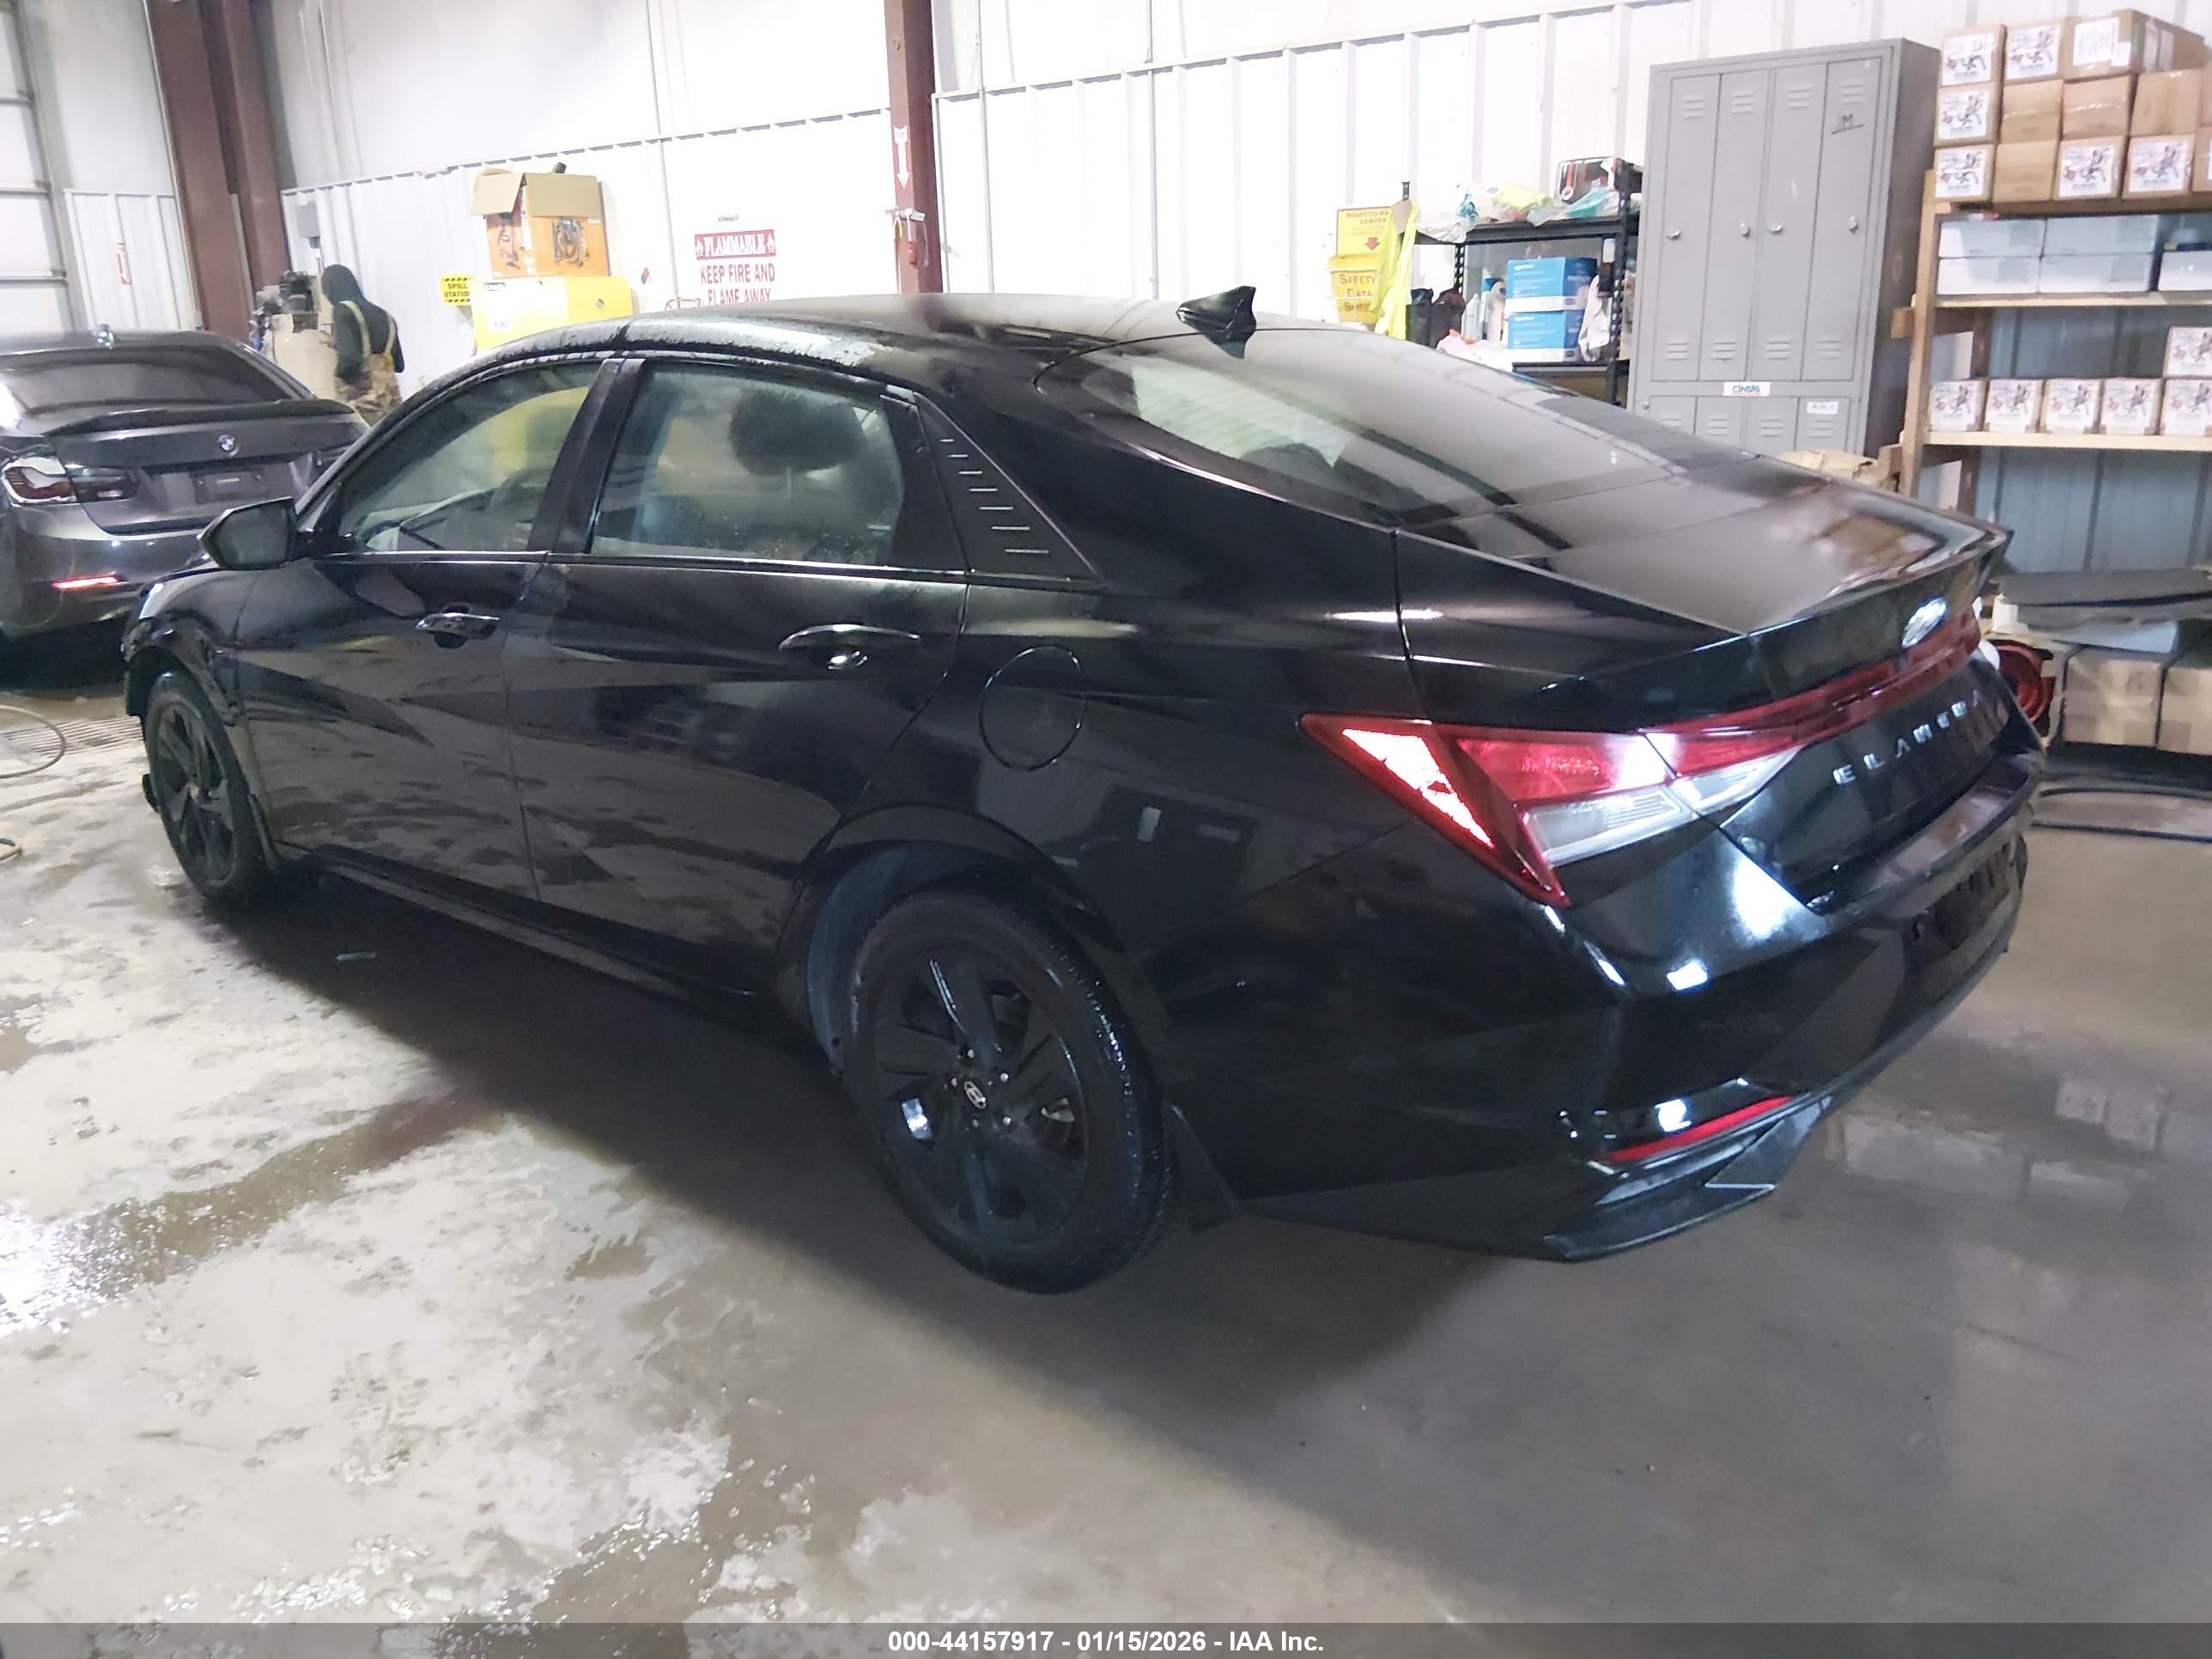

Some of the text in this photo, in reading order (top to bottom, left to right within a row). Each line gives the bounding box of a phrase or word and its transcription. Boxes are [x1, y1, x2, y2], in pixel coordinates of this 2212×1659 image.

[703, 233, 766, 257] FLAMMABLE
[700, 262, 775, 284] KEEP FIRE AND
